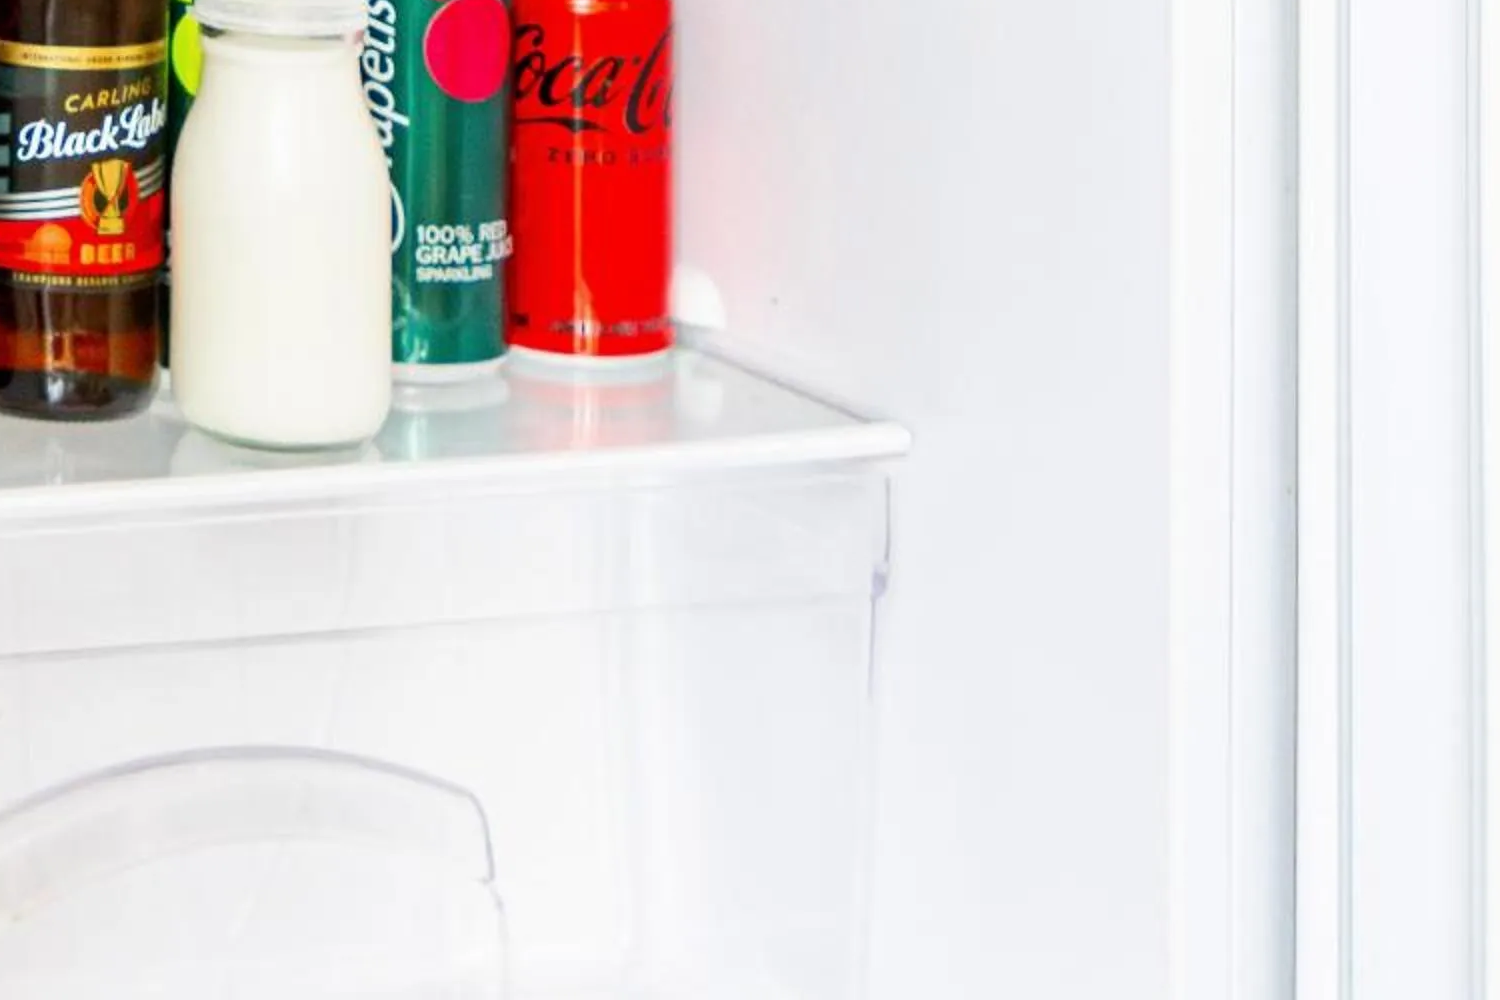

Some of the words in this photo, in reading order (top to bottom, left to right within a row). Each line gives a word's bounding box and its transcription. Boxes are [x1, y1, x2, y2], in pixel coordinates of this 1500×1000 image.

[64, 77, 151, 114] CARLING
[16, 112, 120, 162] Black
[120, 96, 166, 149] Lab
[548, 147, 616, 162] ZERO
[417, 223, 475, 245] 100%
[80, 242, 136, 265] BEER
[415, 244, 482, 265] GRAPE
